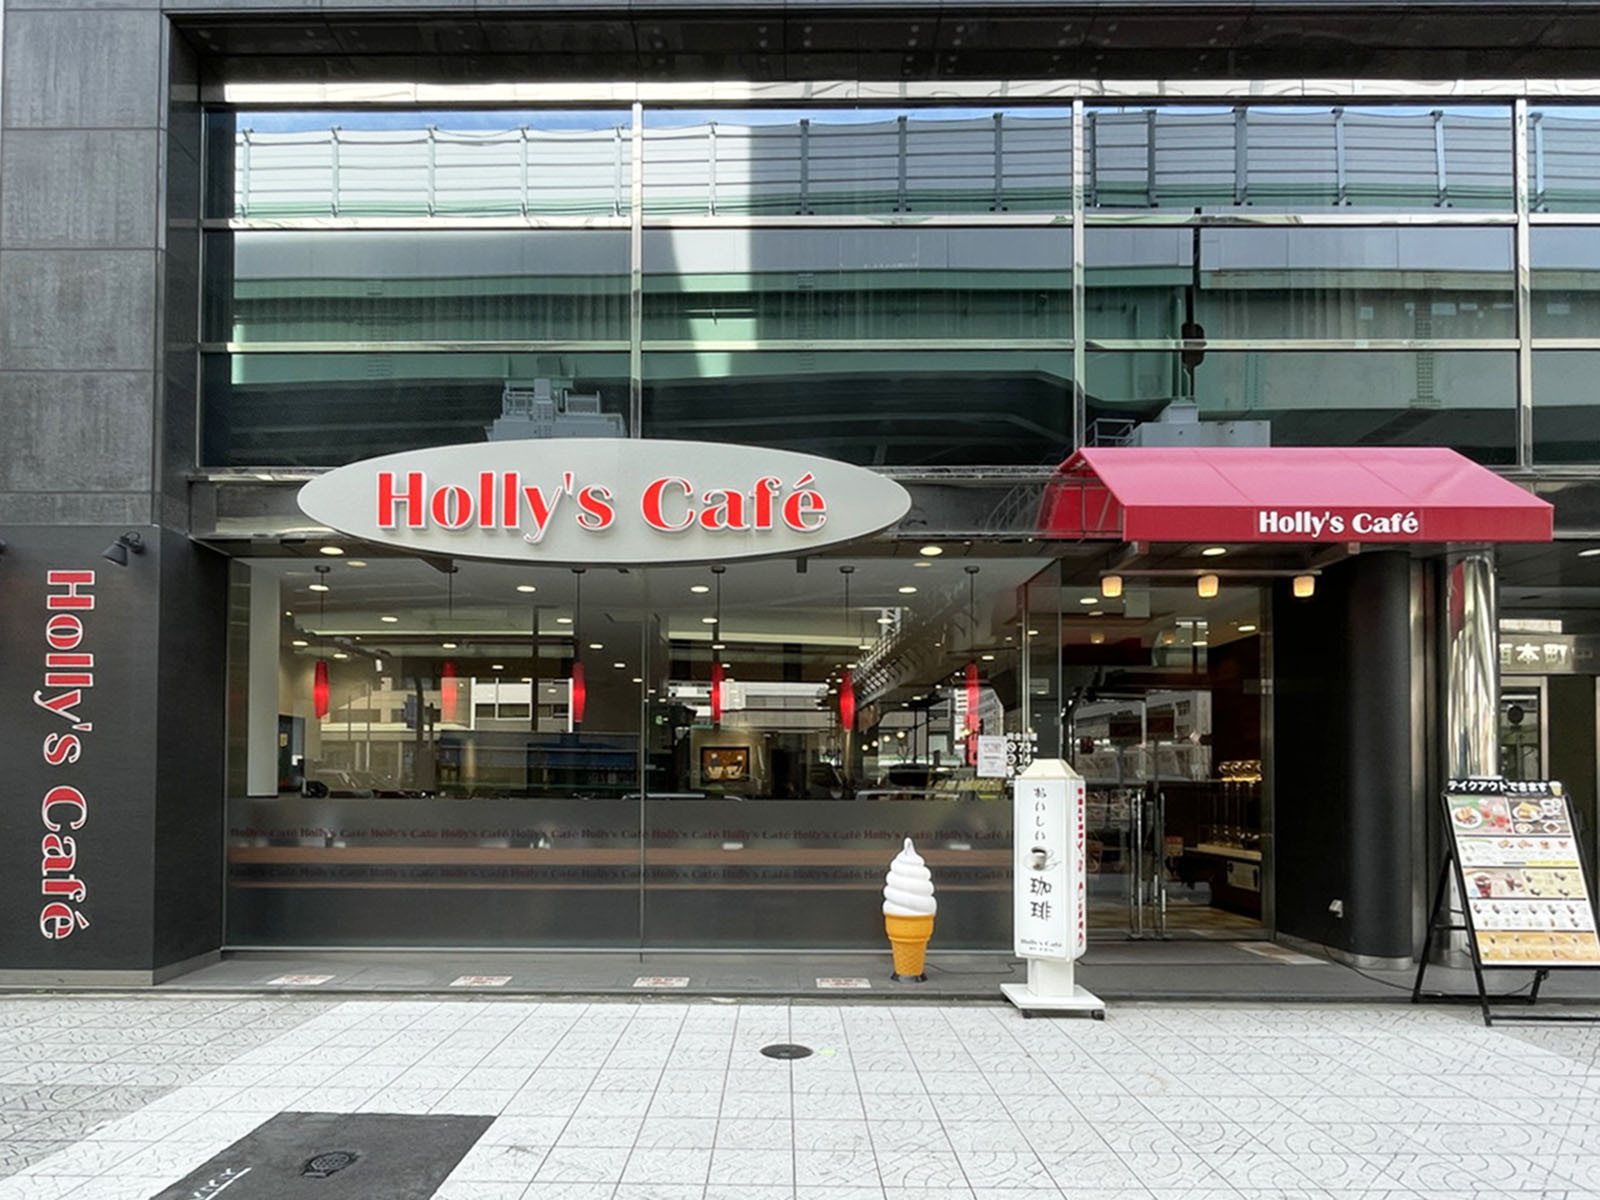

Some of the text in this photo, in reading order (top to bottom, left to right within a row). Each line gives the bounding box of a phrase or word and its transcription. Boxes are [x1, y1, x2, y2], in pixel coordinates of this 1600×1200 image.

[376, 470, 827, 544] Holly's Café
[1258, 511, 1419, 539] Holly's Café
[33, 569, 96, 940] Holly's Café
[1447, 780, 1548, 793] テイクアウトできます
[1029, 787, 1053, 922] おいしい 珈琲
